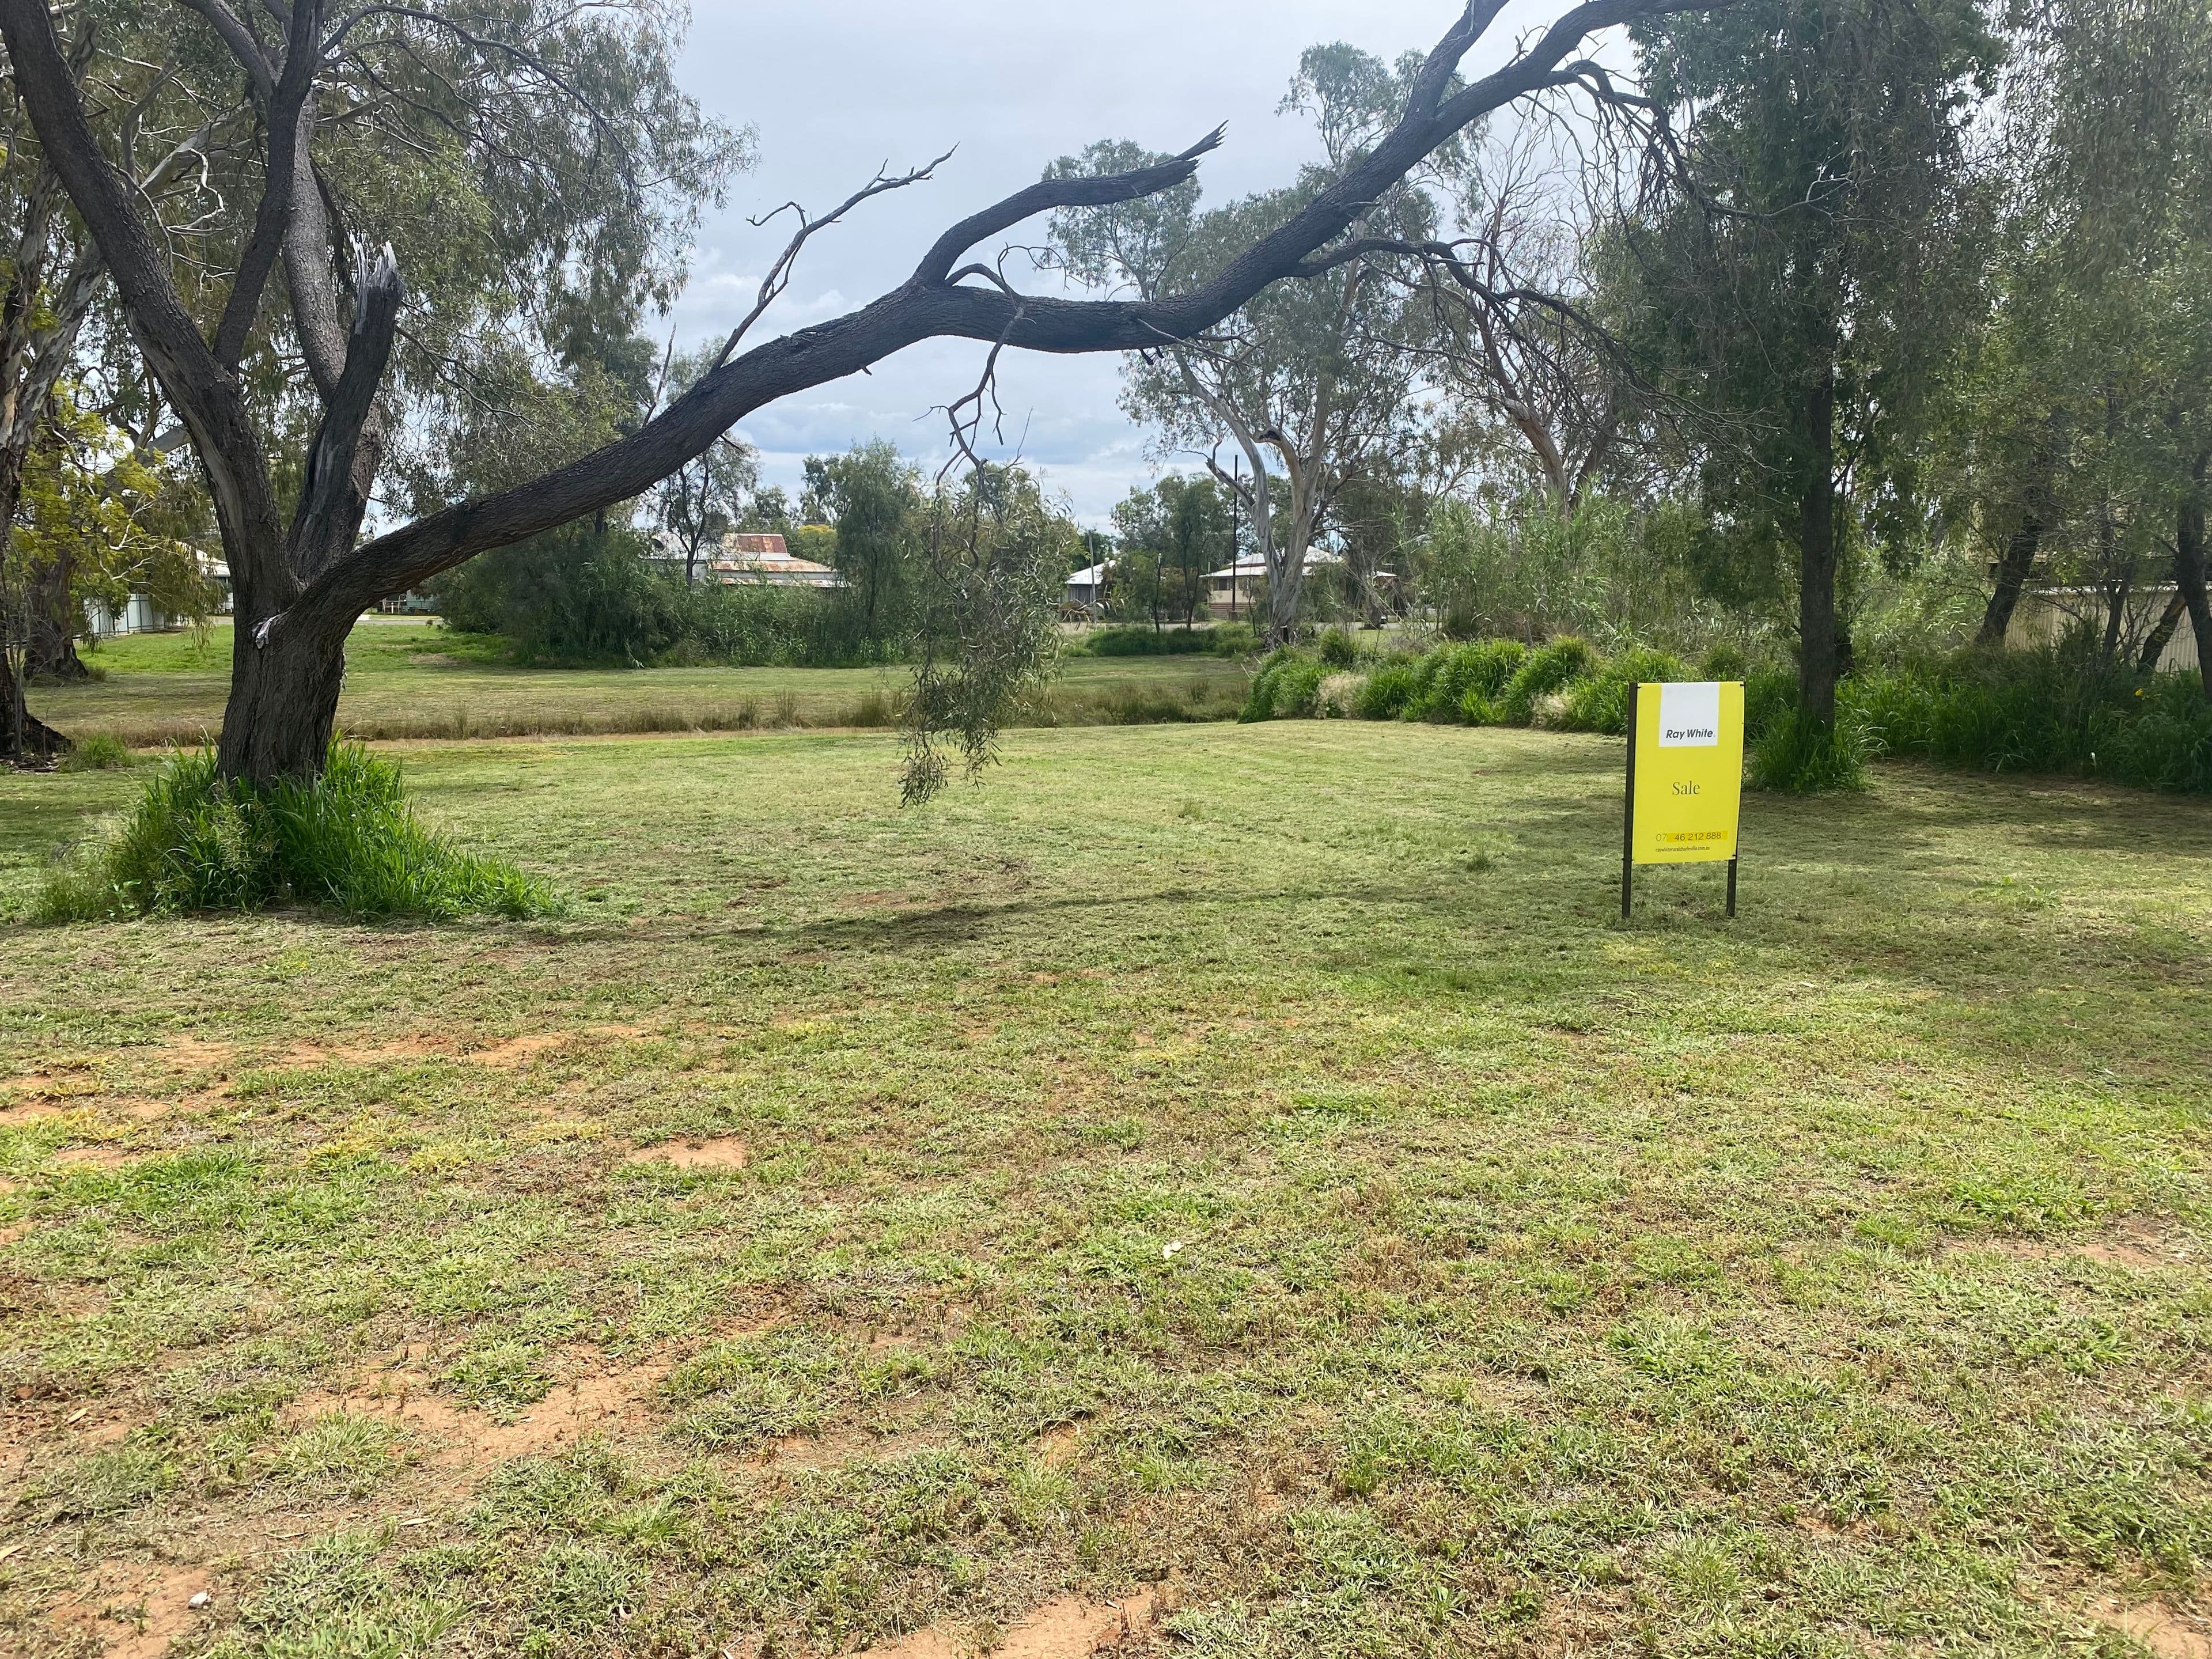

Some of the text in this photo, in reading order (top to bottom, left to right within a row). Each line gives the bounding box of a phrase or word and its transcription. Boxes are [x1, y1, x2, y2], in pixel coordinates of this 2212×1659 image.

[1666, 729, 1713, 740] Ray White
[1672, 781, 1700, 796] Sale
[1656, 834, 1667, 842] 07
[1688, 832, 1704, 840] 212
[1706, 832, 1721, 840] 888
